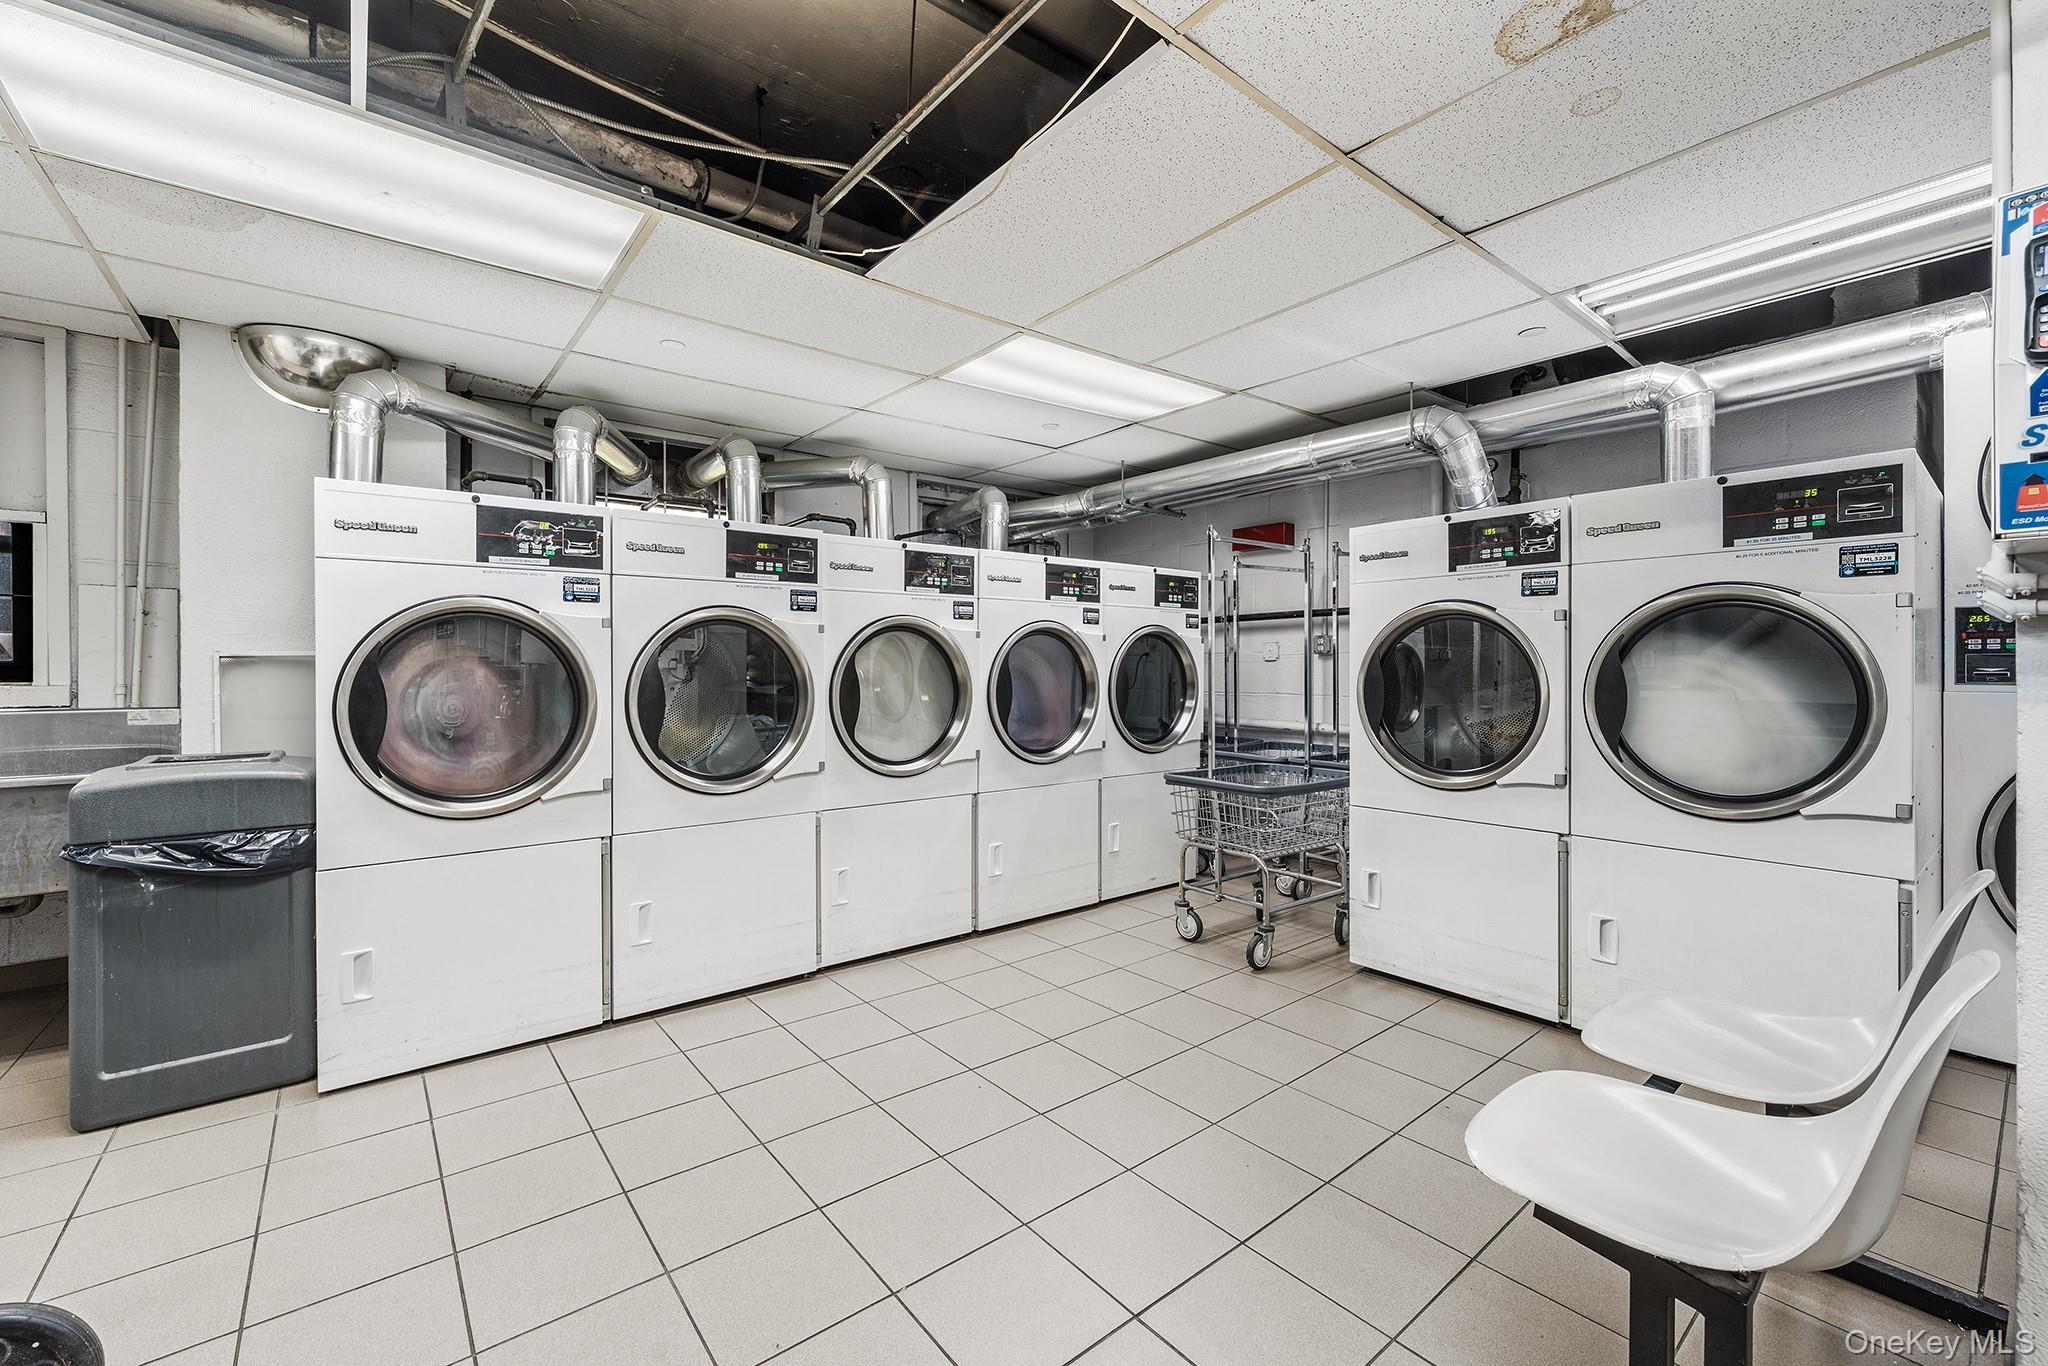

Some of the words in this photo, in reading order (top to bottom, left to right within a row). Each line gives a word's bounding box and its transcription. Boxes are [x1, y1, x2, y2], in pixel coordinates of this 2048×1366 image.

[1804, 488, 1818, 497] 35
[334, 518, 377, 531] Speed
[2011, 517, 2033, 525] ESD
[1586, 523, 1623, 537] Speed
[1622, 520, 1661, 533] Queen
[626, 540, 658, 553] Speed
[657, 543, 686, 555] Queen
